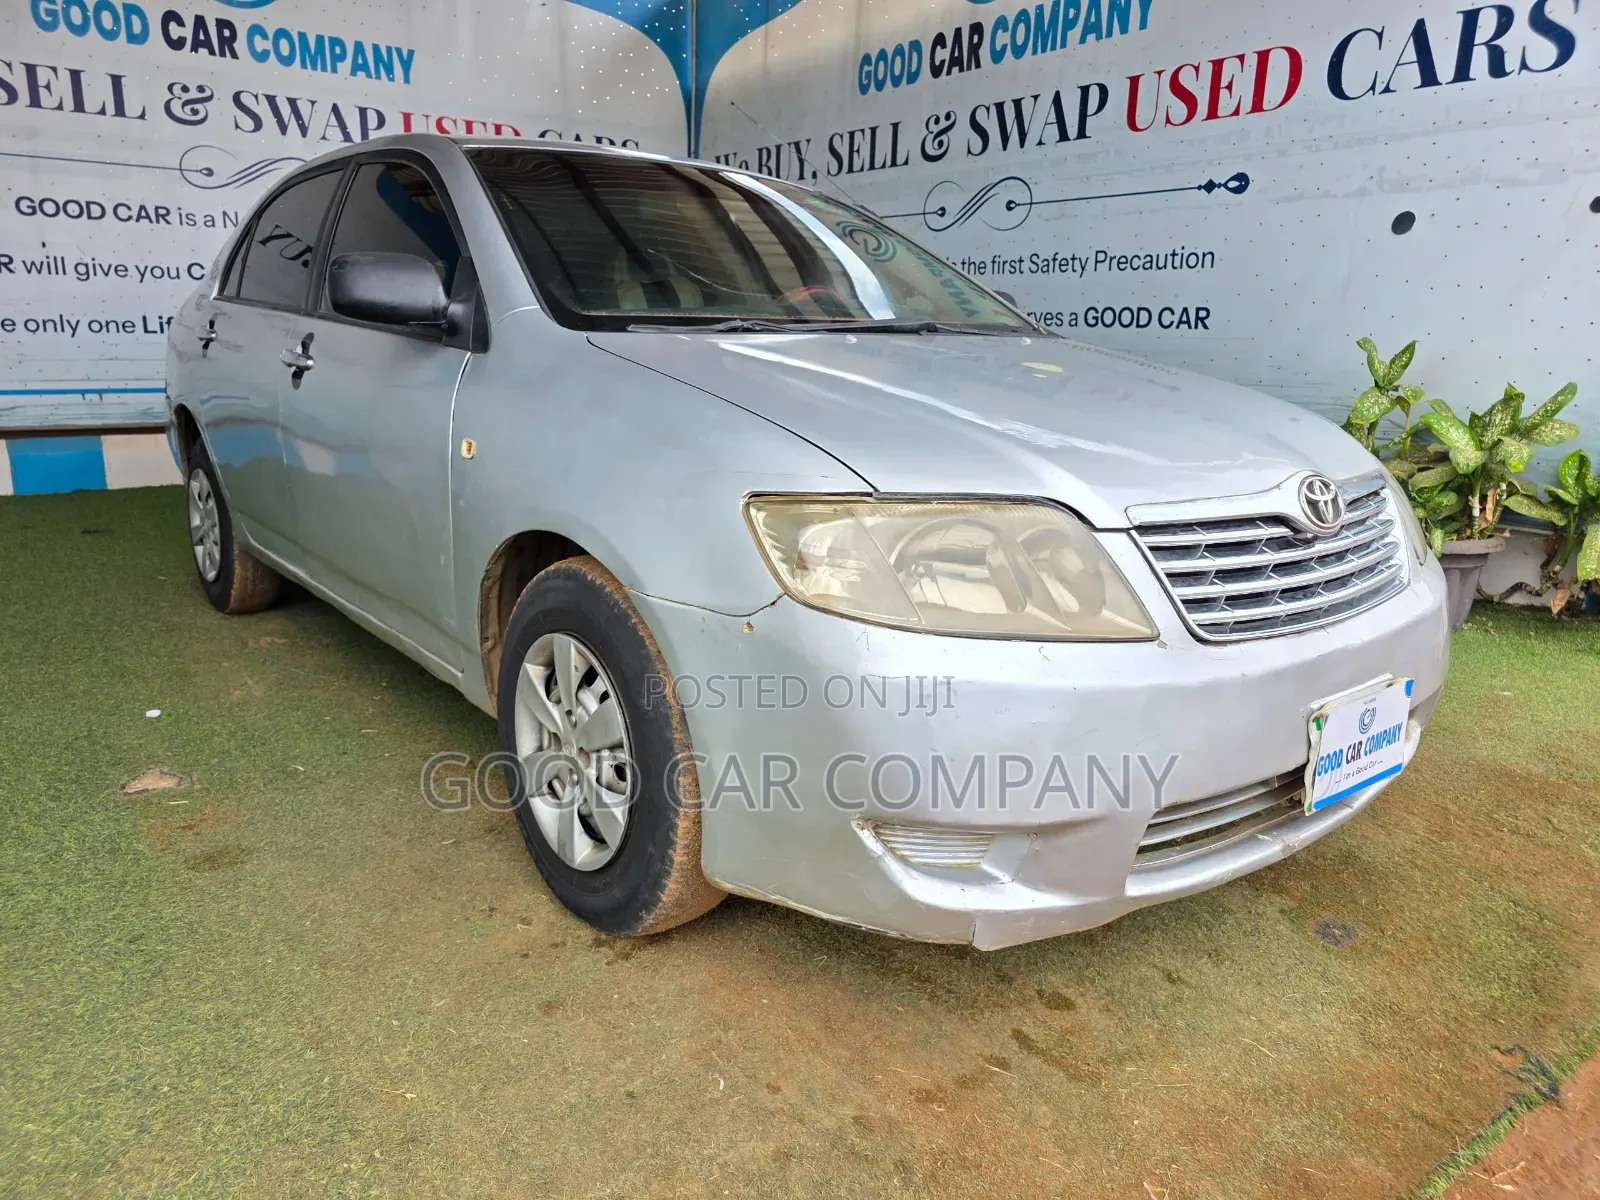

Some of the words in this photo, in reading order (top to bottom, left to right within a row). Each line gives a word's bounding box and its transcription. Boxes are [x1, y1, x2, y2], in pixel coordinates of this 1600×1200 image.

[31, 0, 150, 45] GOOD
[161, 10, 239, 60] CAR
[246, 24, 415, 85] COMPANY
[857, 38, 922, 96] GOOD
[929, 21, 984, 79] CAR
[989, 0, 1152, 65] COMPANY
[163, 82, 214, 126] &
[232, 90, 386, 143] SWAP
[756, 138, 818, 187] BUY,
[827, 121, 909, 177] SELL
[920, 109, 957, 163] &
[966, 82, 1109, 157] SWAP
[1125, 45, 1302, 133] USED
[1327, 0, 1580, 101] CARS
[15, 196, 106, 220] GOOD
[113, 203, 172, 224] CAR
[178, 208, 197, 227] is
[203, 214, 215, 228] a
[21, 255, 67, 276] will
[74, 258, 129, 281] give
[135, 263, 180, 283] you
[960, 256, 987, 275] the
[991, 254, 1024, 275] first
[1028, 252, 1089, 278] Safety
[1093, 245, 1215, 272] Precaution
[24, 313, 80, 338] only
[88, 317, 136, 333] one
[1068, 311, 1078, 327] a
[1084, 306, 1152, 329] GOOD
[1158, 306, 1211, 329] CAR
[1316, 748, 1342, 776] GOOD
[1345, 740, 1363, 765] CAR
[1364, 723, 1402, 756] COMPANY
